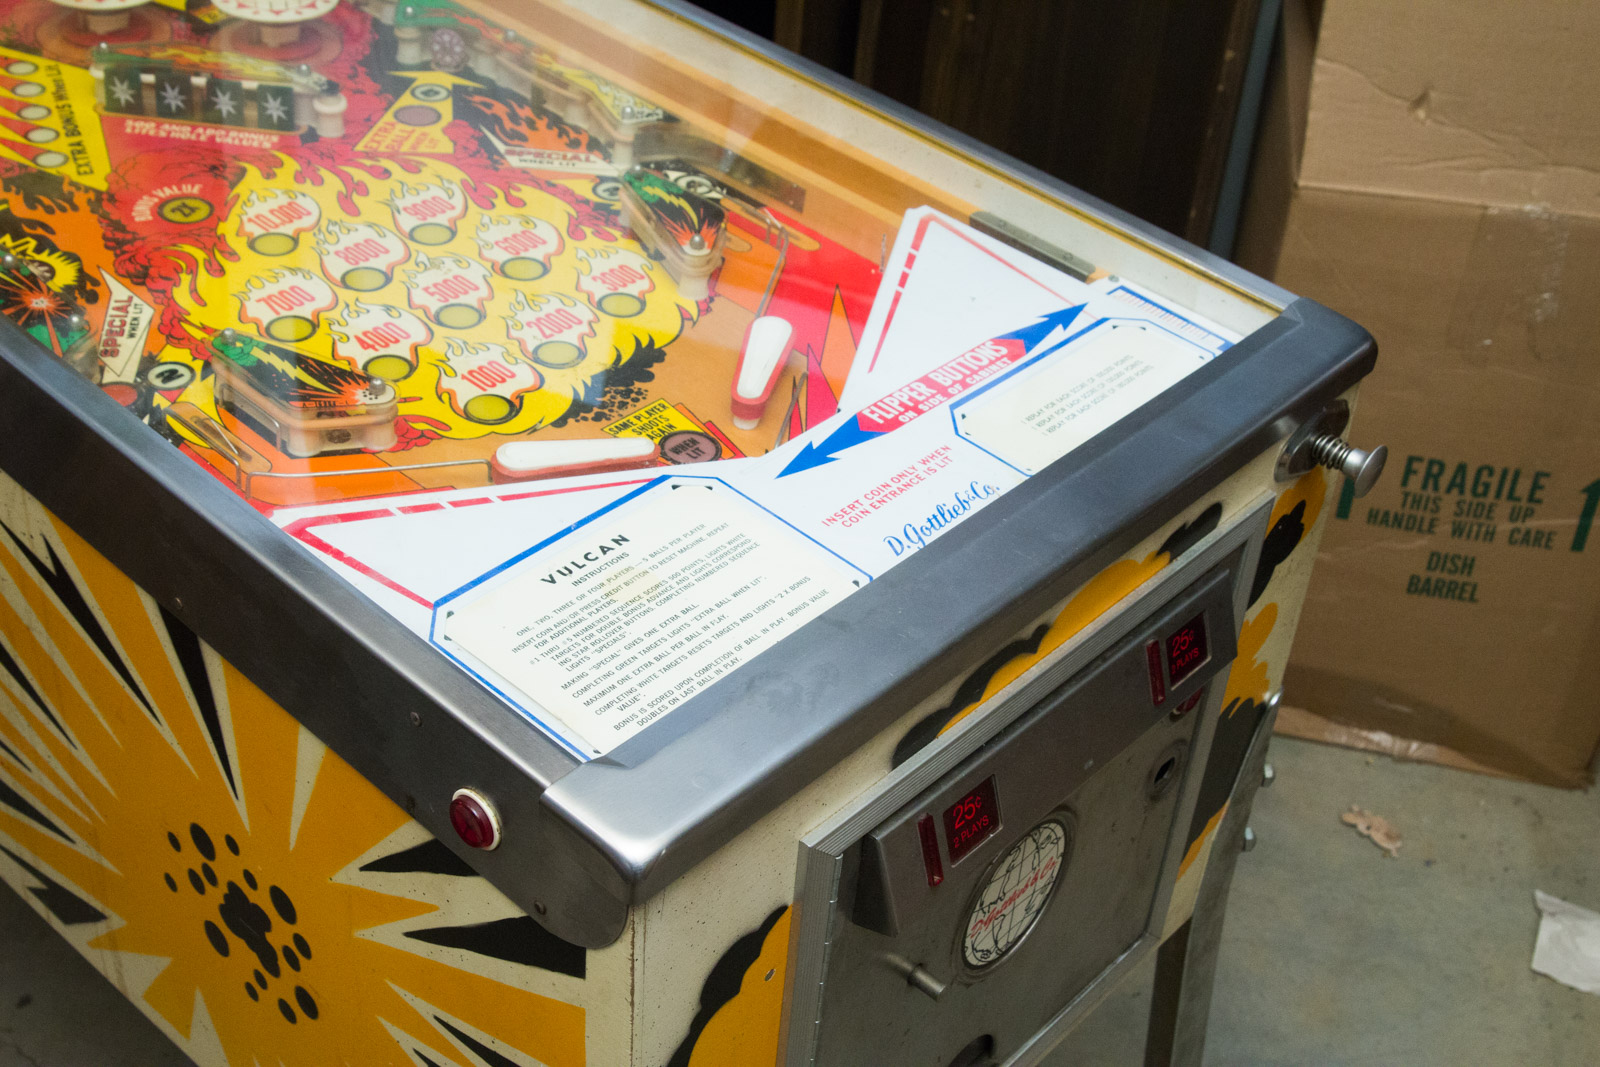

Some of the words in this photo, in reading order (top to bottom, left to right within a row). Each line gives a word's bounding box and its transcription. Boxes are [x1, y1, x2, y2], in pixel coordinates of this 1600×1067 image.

[56, 104, 82, 138] BONUS
[68, 140, 94, 176] EXTRA
[152, 184, 203, 198] VALUE
[402, 196, 456, 222] 9000
[333, 236, 390, 267] 8000
[494, 229, 548, 256] 6000
[422, 274, 480, 303] 5000
[591, 264, 646, 292] 3000
[132, 302, 144, 315] LIT
[255, 284, 316, 316] 7000
[100, 295, 134, 358] SPECIAL
[126, 316, 140, 339] WHEN
[354, 322, 411, 352] 4000
[525, 308, 584, 340] 2000
[460, 360, 517, 392] 1000
[861, 380, 938, 424] FLIPPER
[927, 340, 1008, 392] BUTTONS
[897, 408, 918, 424] ON
[918, 394, 947, 413] SIDE
[950, 382, 963, 396] OF
[966, 356, 1013, 386] CABINET
[608, 418, 638, 435] SAME
[634, 402, 670, 424] PLAYER
[631, 414, 670, 436] SHOOTS
[646, 422, 678, 442] AGAIN
[668, 437, 700, 456] WHEN
[686, 446, 706, 460] LIT
[822, 498, 864, 527] INSERT
[864, 482, 892, 501] COIN
[890, 464, 920, 485] ONLY
[917, 444, 952, 466] WHEN
[841, 507, 871, 528] COIN
[870, 472, 926, 510] ENTRANCE
[922, 464, 937, 476] IS
[936, 456, 953, 472] LIT
[1401, 455, 1551, 504] FRAGILE
[1401, 490, 1442, 514] THIS
[1453, 498, 1497, 521] SIDE
[1508, 504, 1535, 524] UP
[1367, 507, 1440, 535] HANDLE
[1451, 520, 1496, 544] WITH
[1508, 527, 1558, 550] CARE
[541, 534, 630, 586] VULCAN
[552, 601, 575, 615] THREE
[587, 583, 606, 594] FOUR
[606, 566, 634, 583] PLAYERS
[648, 546, 669, 558] BALLS
[668, 538, 682, 546] PER
[682, 524, 706, 538] PLAYER
[570, 551, 630, 587] INSTRUCTIONS
[1426, 551, 1476, 576] DISH
[511, 638, 536, 653] INSERT
[535, 627, 553, 638] COIN
[579, 599, 601, 612] PRESS
[600, 585, 624, 600] CREDIT
[623, 570, 649, 586] BUTTON
[658, 553, 678, 565] RESET
[706, 523, 729, 537] REPEAT
[540, 645, 560, 657] THRU
[572, 615, 610, 638] NUMBERED
[609, 595, 644, 616] SEQUENCE
[643, 580, 668, 595] SCORES
[668, 572, 681, 580] 500
[705, 545, 727, 558] LIGHTS
[726, 533, 746, 545] WHITE
[558, 657, 572, 666] ING
[571, 646, 590, 658] STAR
[590, 625, 623, 646] ROLLOVER
[655, 582, 695, 606] COMPLETING
[694, 561, 729, 582] NUMBERED
[728, 542, 760, 562] SEQUENCE
[1406, 574, 1478, 604] BARREL
[550, 642, 581, 661] TARGETS
[581, 633, 595, 642] FOR
[595, 616, 623, 633] DOUBLE
[622, 602, 646, 617] BONUS
[645, 585, 675, 603] ADVANCE
[675, 576, 689, 585] AND
[689, 562, 712, 576] LIGHTS
[534, 639, 549, 649] FOR
[549, 616, 588, 640] ADDITIONAL
[571, 670, 615, 698] COMPLETING
[614, 655, 638, 671] GREEN
[638, 637, 667, 656] TARGETS
[667, 622, 691, 638] LIGHTS
[714, 597, 731, 608] BALL
[731, 585, 750, 597] WHEN
[594, 687, 637, 715] COMPLETING
[637, 673, 659, 688] WHITE
[658, 655, 688, 674] TARGETS
[687, 639, 712, 655] RESETS
[711, 622, 739, 640] TARGETS
[738, 613, 754, 622] AND
[752, 599, 775, 613] LIGHTS
[789, 576, 811, 590] BONUS
[560, 671, 588, 689] MAKING
[623, 637, 644, 650] GIVES
[643, 627, 659, 638] ONE
[659, 614, 680, 628] EXTRA
[565, 655, 590, 671] LIGHTS
[582, 684, 617, 706] MAXIMUM
[616, 674, 632, 685] ONE
[632, 661, 654, 675] EXTRA
[653, 650, 671, 661] BALL
[670, 641, 685, 651] PER
[684, 630, 702, 642] BALL
[613, 713, 638, 730] BONUS
[647, 690, 675, 708] SCORED
[674, 677, 694, 690] UPON
[693, 651, 734, 678] COMPLETION
[744, 634, 761, 645] BALL
[787, 602, 809, 616] BONUS
[808, 589, 829, 602] VALUE
[636, 704, 668, 726] DOUBLES
[668, 697, 680, 705] ON
[679, 686, 697, 697] LAST
[696, 674, 714, 686] BALL
[954, 836, 960, 848] 2
[960, 815, 990, 842] PLAYS
